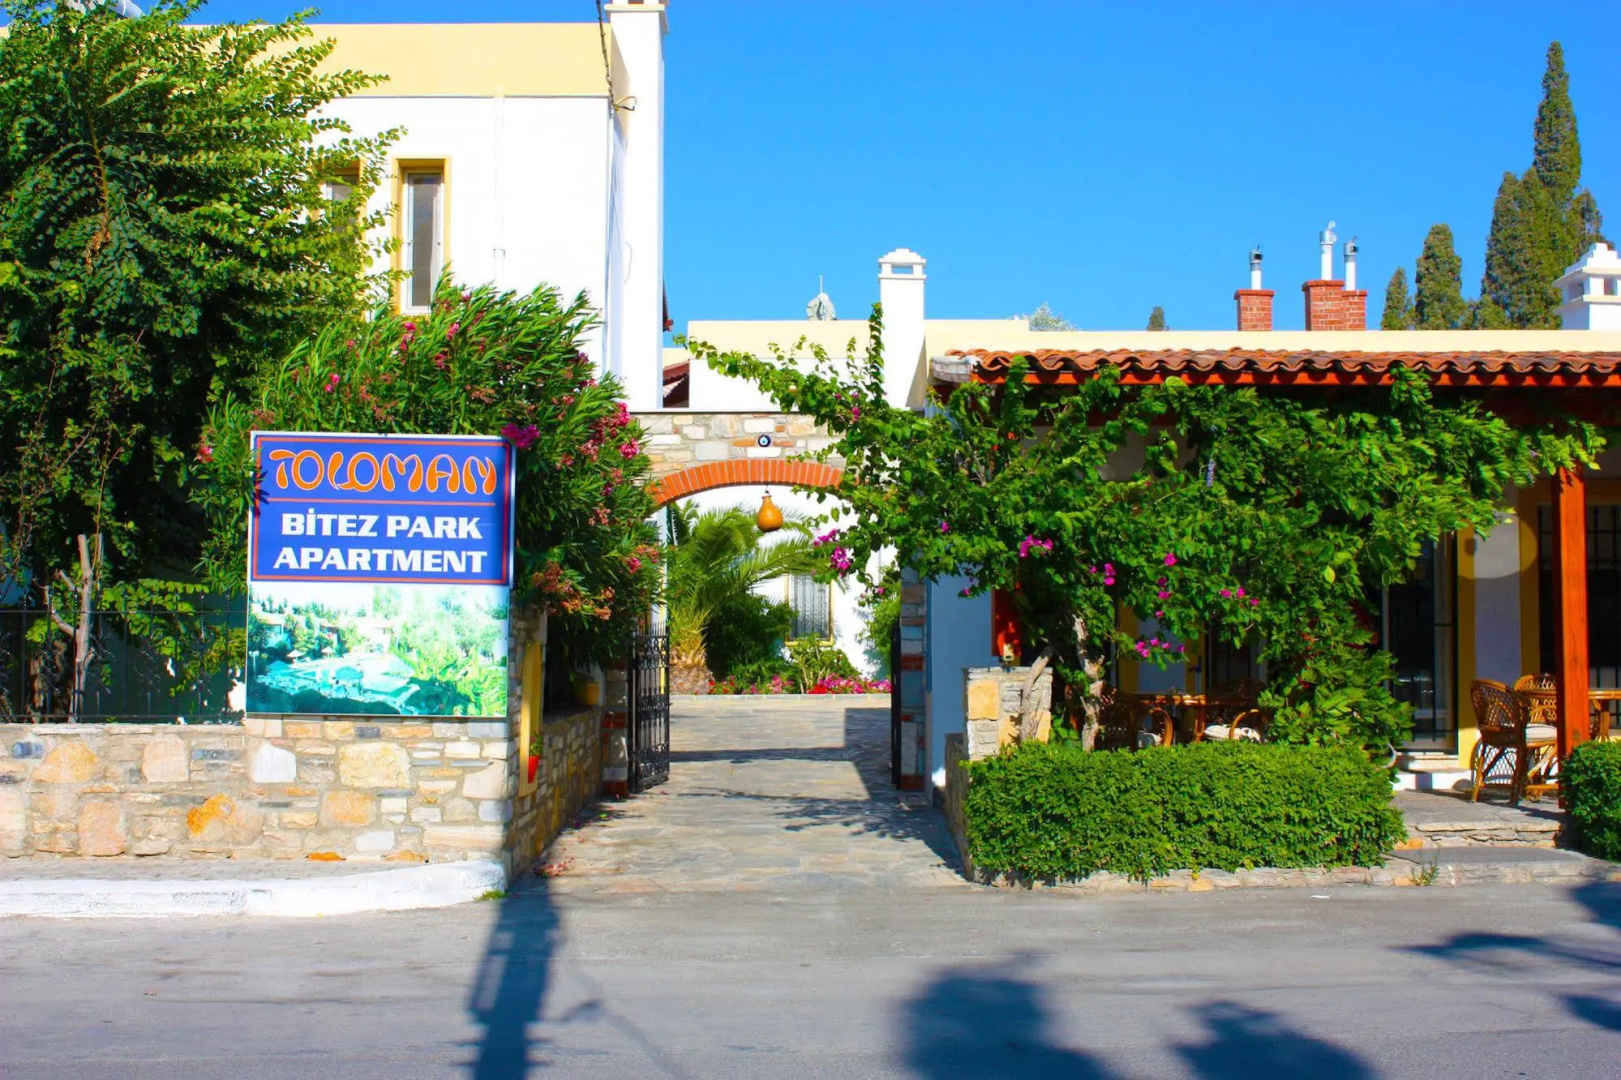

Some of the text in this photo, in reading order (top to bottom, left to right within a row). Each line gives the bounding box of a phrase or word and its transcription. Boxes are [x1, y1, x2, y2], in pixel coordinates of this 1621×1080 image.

[269, 449, 497, 495] TOLOMAN
[281, 508, 483, 539] BİTEZ PARK
[273, 547, 487, 573] APARTMENT
